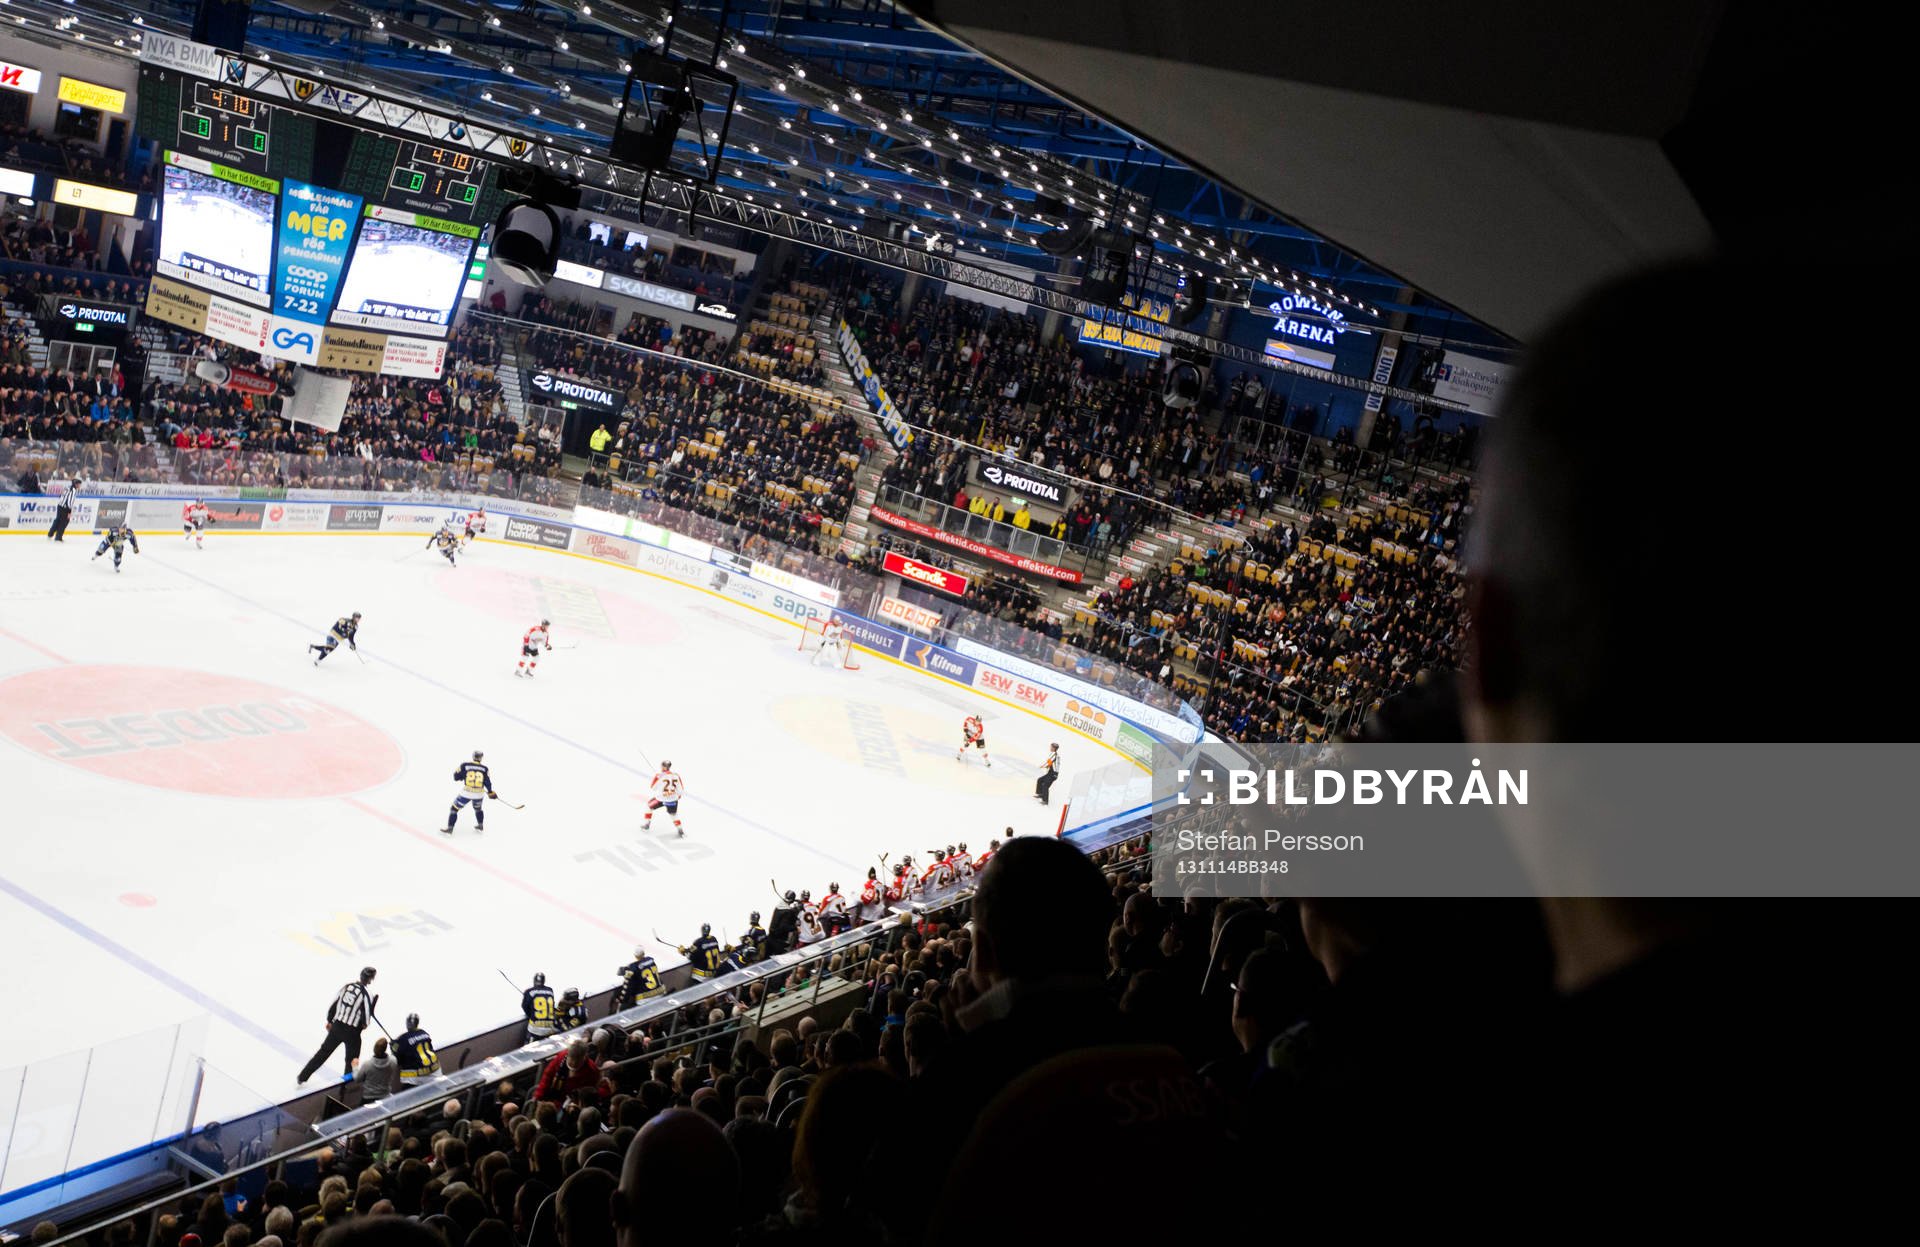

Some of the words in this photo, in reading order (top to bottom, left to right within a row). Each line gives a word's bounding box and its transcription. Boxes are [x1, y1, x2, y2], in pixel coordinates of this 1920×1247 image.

[146, 33, 176, 59] NYA
[179, 42, 218, 69] BMW
[212, 89, 249, 115] 4:10
[432, 148, 469, 170] 4:10
[219, 167, 227, 176] Vi
[227, 170, 238, 179] har
[238, 173, 248, 183] tid
[287, 211, 347, 242] MER
[423, 217, 430, 226] Vi
[430, 219, 441, 228] har
[441, 221, 451, 231] tid
[303, 237, 326, 251] FÖR
[284, 283, 325, 299] FORUM
[609, 277, 689, 306] SKANSKA
[78, 306, 127, 324] PROTOTAL
[284, 295, 318, 315] 7-22
[1273, 317, 1335, 345] ARENA
[554, 380, 613, 406] PROTOTAL
[1003, 473, 1059, 502] PROTOTAL
[509, 518, 538, 533] happy
[934, 531, 988, 556] effektid.com
[902, 561, 947, 588] Scandic
[1016, 558, 1077, 582] effektid.com
[772, 593, 818, 619] sapa
[840, 620, 894, 649] AGERHULT
[930, 653, 964, 676] Kitron
[982, 670, 1014, 693] SEW
[1015, 683, 1049, 703] SEW
[465, 771, 484, 788] 22
[662, 779, 678, 793] 25
[534, 996, 554, 1019] 91
[415, 1041, 438, 1066] 11
